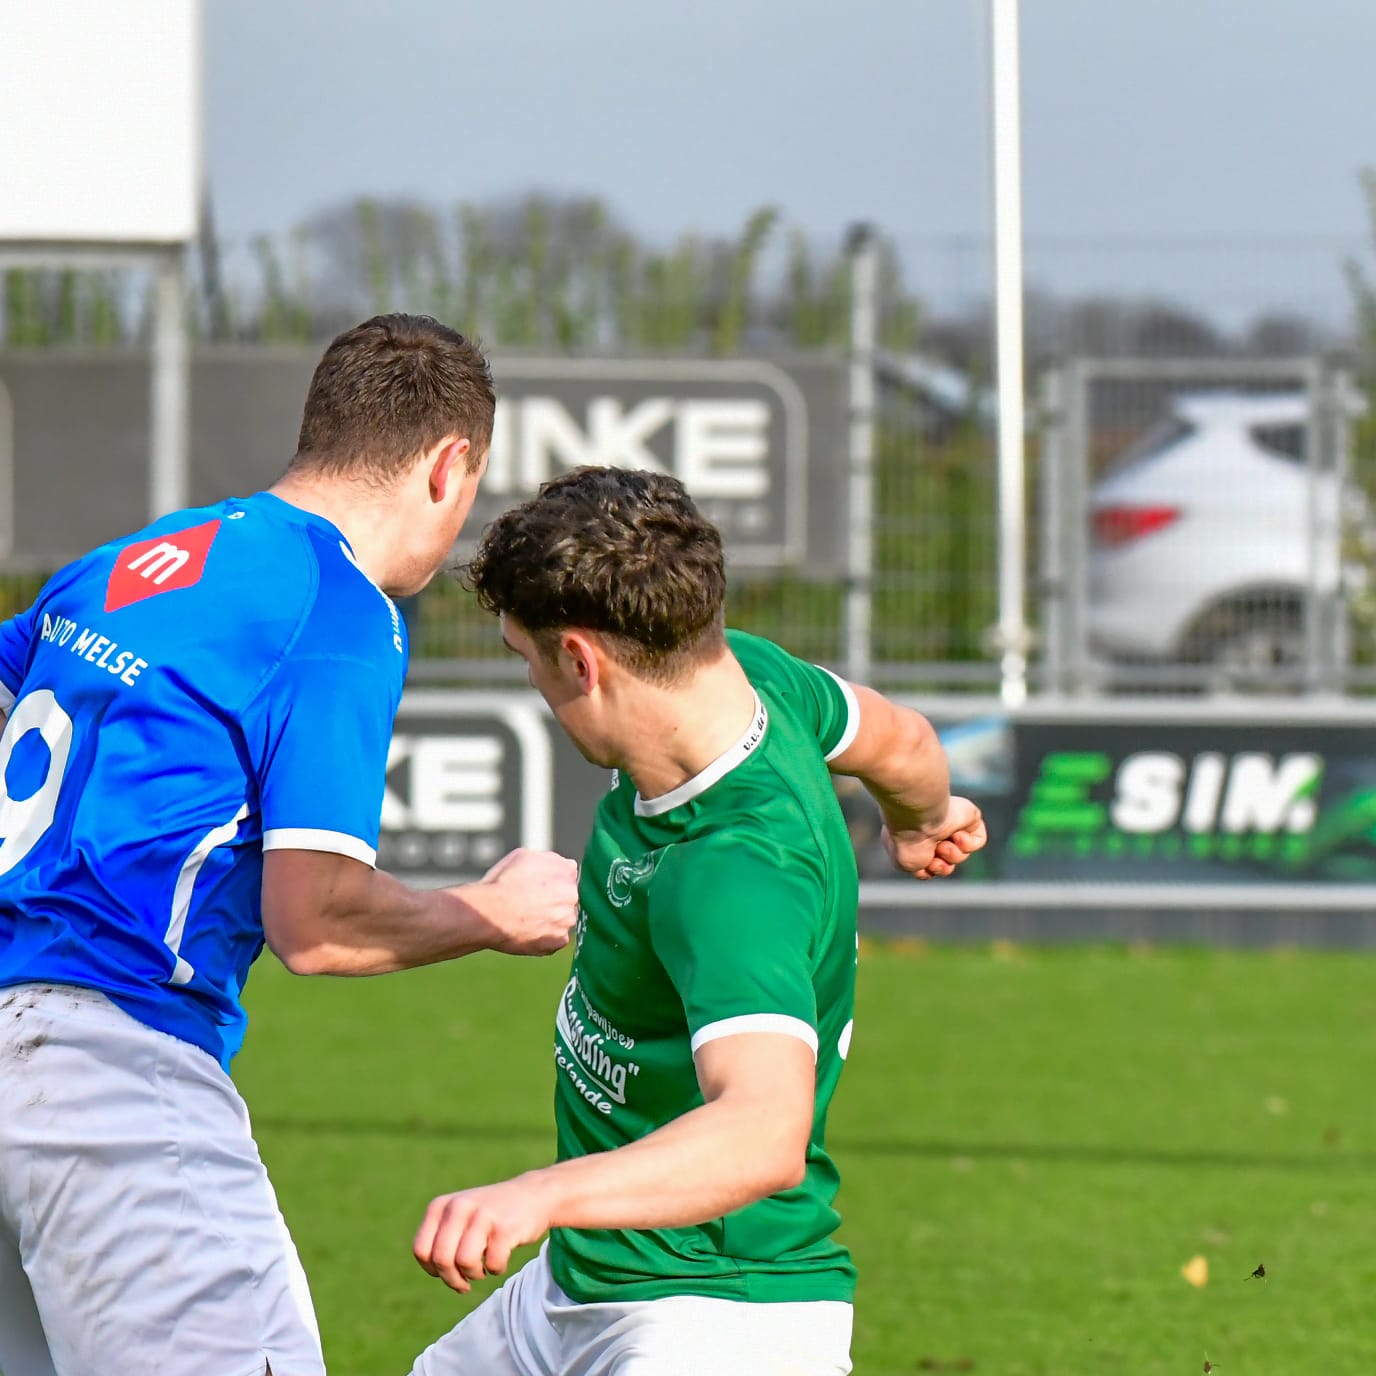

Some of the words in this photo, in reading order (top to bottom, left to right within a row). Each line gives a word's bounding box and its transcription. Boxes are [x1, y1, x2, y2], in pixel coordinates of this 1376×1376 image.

[484, 396, 773, 494] INKE
[41, 613, 77, 647] AUTO
[70, 628, 149, 687] MELSE
